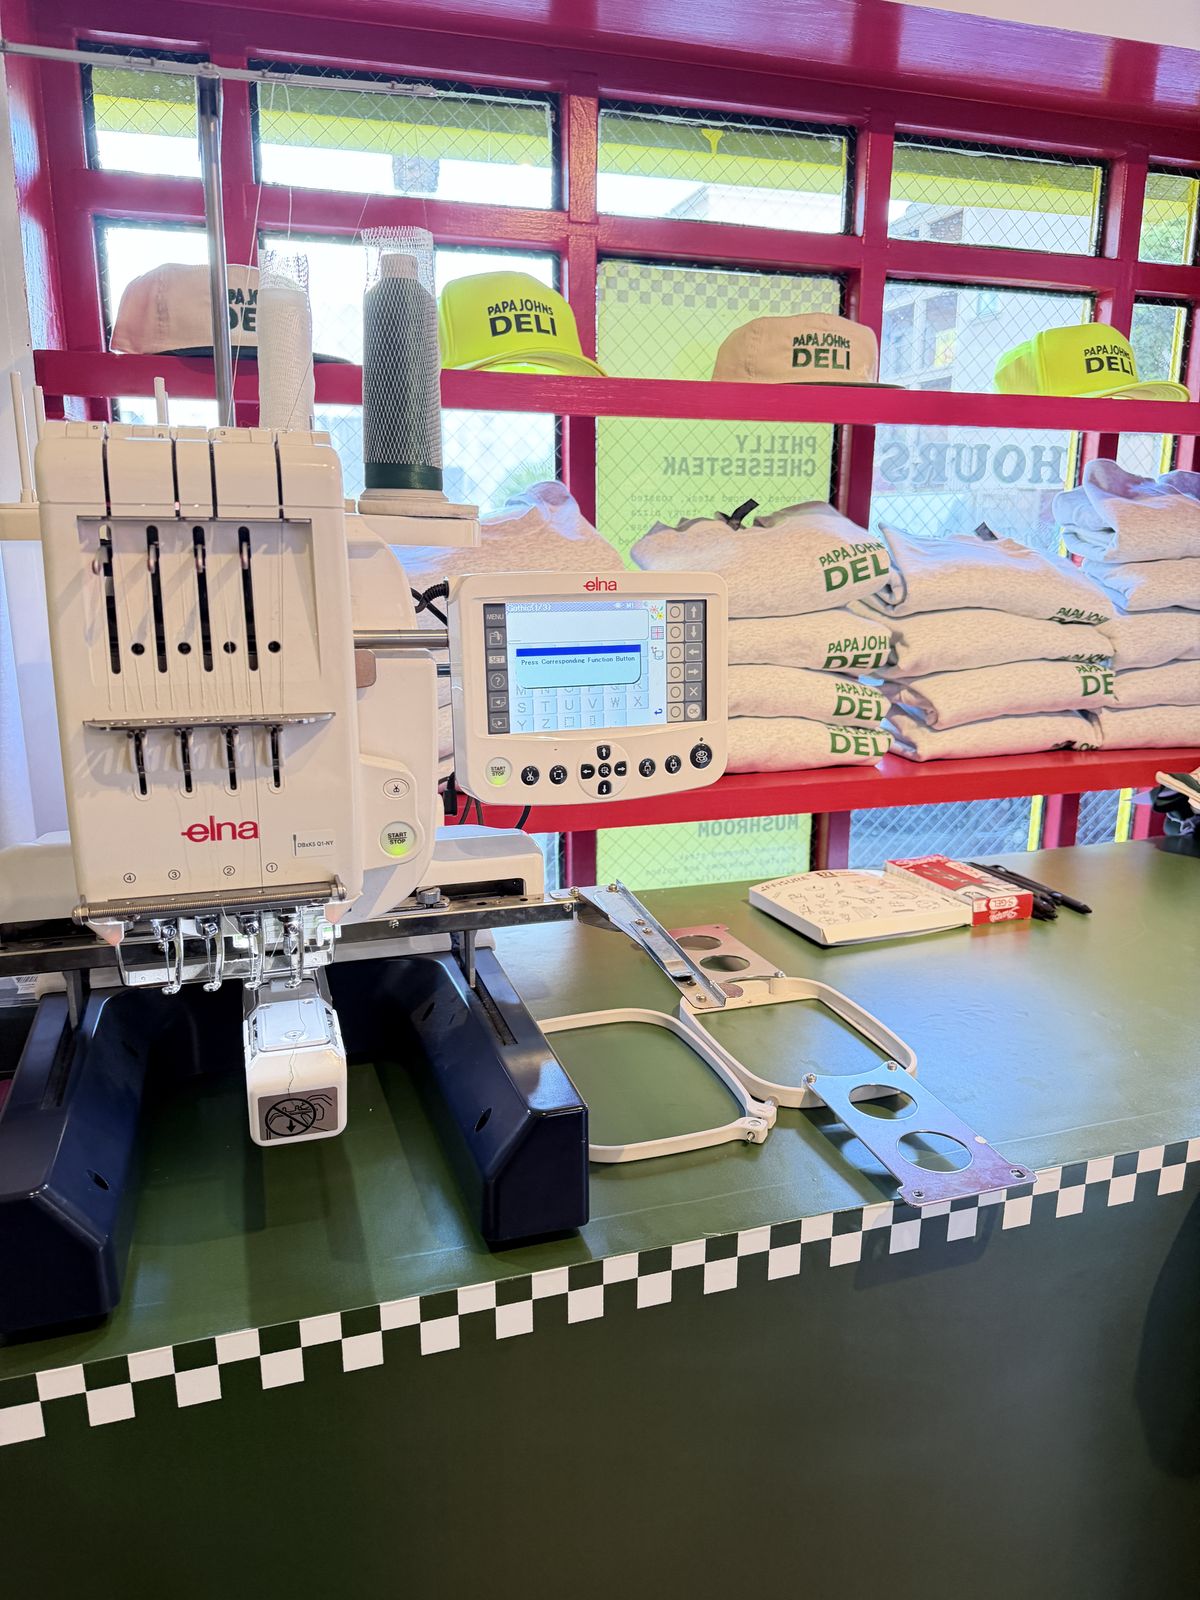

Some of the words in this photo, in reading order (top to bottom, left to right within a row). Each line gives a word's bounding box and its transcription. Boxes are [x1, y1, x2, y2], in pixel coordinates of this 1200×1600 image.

[487, 299, 518, 316] PAPA
[229, 306, 257, 332] DE
[489, 313, 557, 337] DELI
[792, 332, 820, 347] PAPA
[792, 347, 850, 370] DELI
[1083, 344, 1109, 357] PAPA
[1085, 355, 1134, 376] DELI
[818, 546, 852, 567] PAPA
[849, 541, 886, 557] JOHN
[823, 553, 890, 592] DEL
[582, 576, 618, 592] elna
[827, 637, 860, 654] PAPA
[861, 635, 887, 651] JOH
[541, 657, 585, 665] Corresponding
[1080, 673, 1114, 697] DE
[517, 702, 527, 713] S
[541, 701, 550, 712] T
[564, 699, 574, 711] U
[588, 699, 598, 709] V
[610, 697, 620, 707] W
[633, 696, 642, 706] X
[832, 695, 887, 721] DEL
[517, 720, 527, 731] Y
[542, 718, 551, 729] Z
[181, 815, 259, 843] elna
